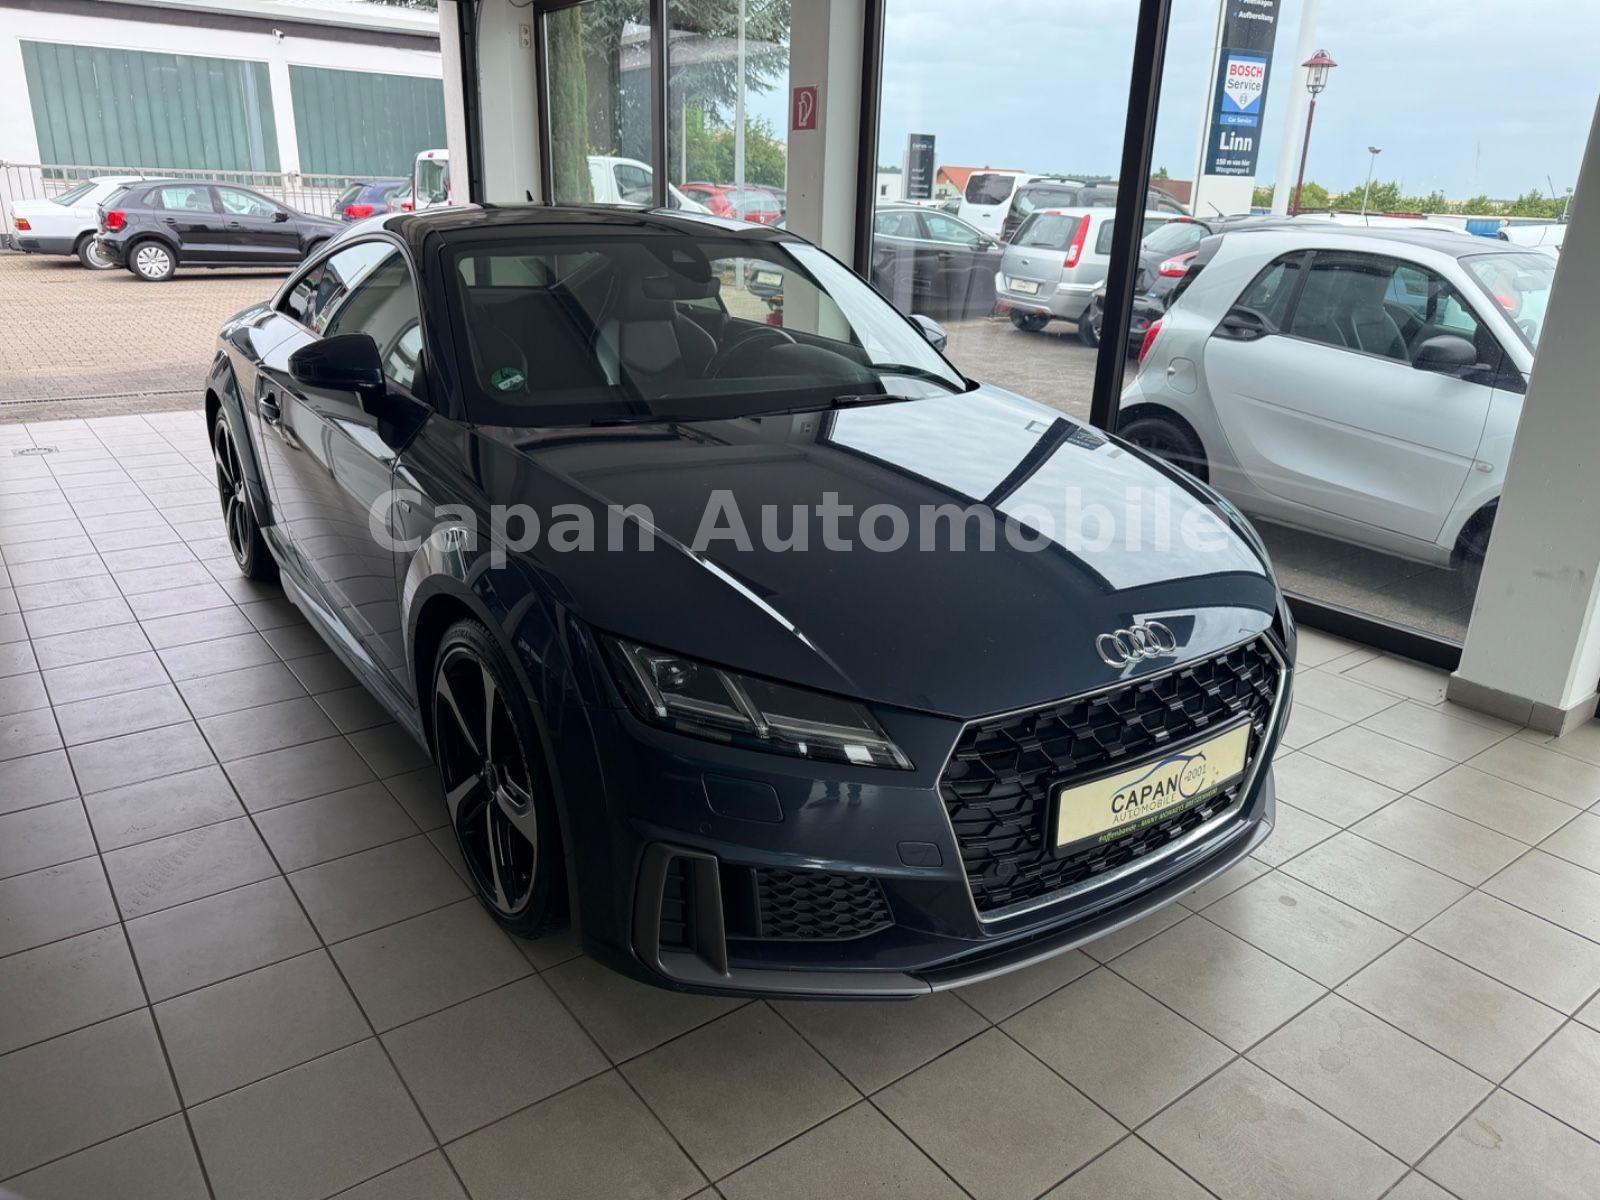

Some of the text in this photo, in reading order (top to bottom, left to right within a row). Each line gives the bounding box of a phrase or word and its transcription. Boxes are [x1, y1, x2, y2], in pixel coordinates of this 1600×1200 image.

[1238, 11, 1274, 23] Aufbereitung
[1229, 64, 1263, 78] BOSCH
[1227, 79, 1261, 91] Service
[1219, 131, 1253, 151] Linn
[1111, 774, 1179, 814] CAPAN
[1112, 792, 1175, 825] AUTOMOBILE
